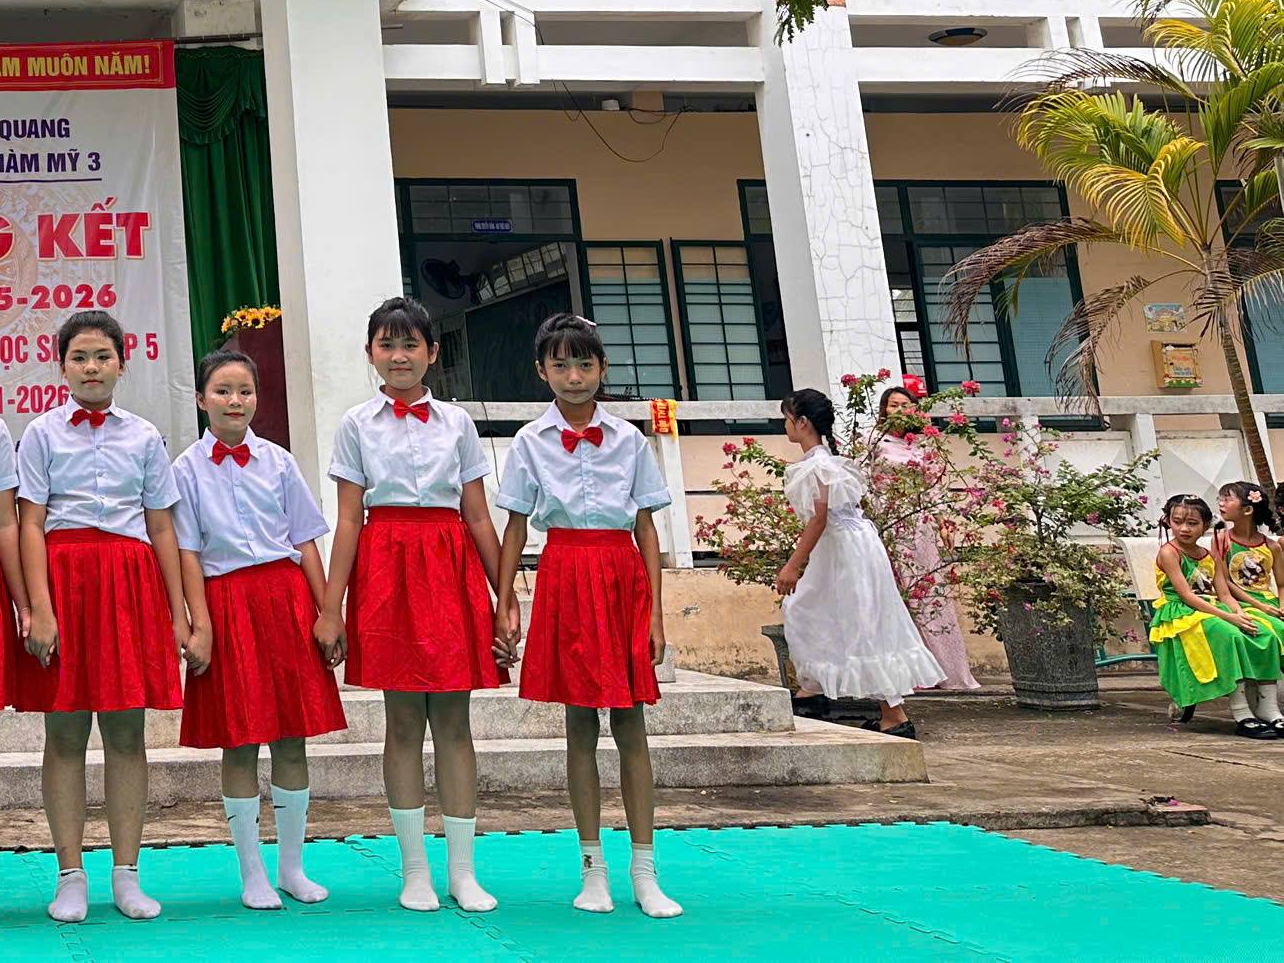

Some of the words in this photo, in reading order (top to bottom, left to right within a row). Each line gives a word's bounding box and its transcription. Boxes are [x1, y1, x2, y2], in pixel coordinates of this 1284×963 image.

[27, 53, 88, 77] MUÔN
[95, 51, 150, 76] NĂM!
[47, 148, 80, 173] MỸ
[87, 152, 101, 172] 3
[37, 196, 151, 261] KẾT
[145, 332, 159, 361] 5
